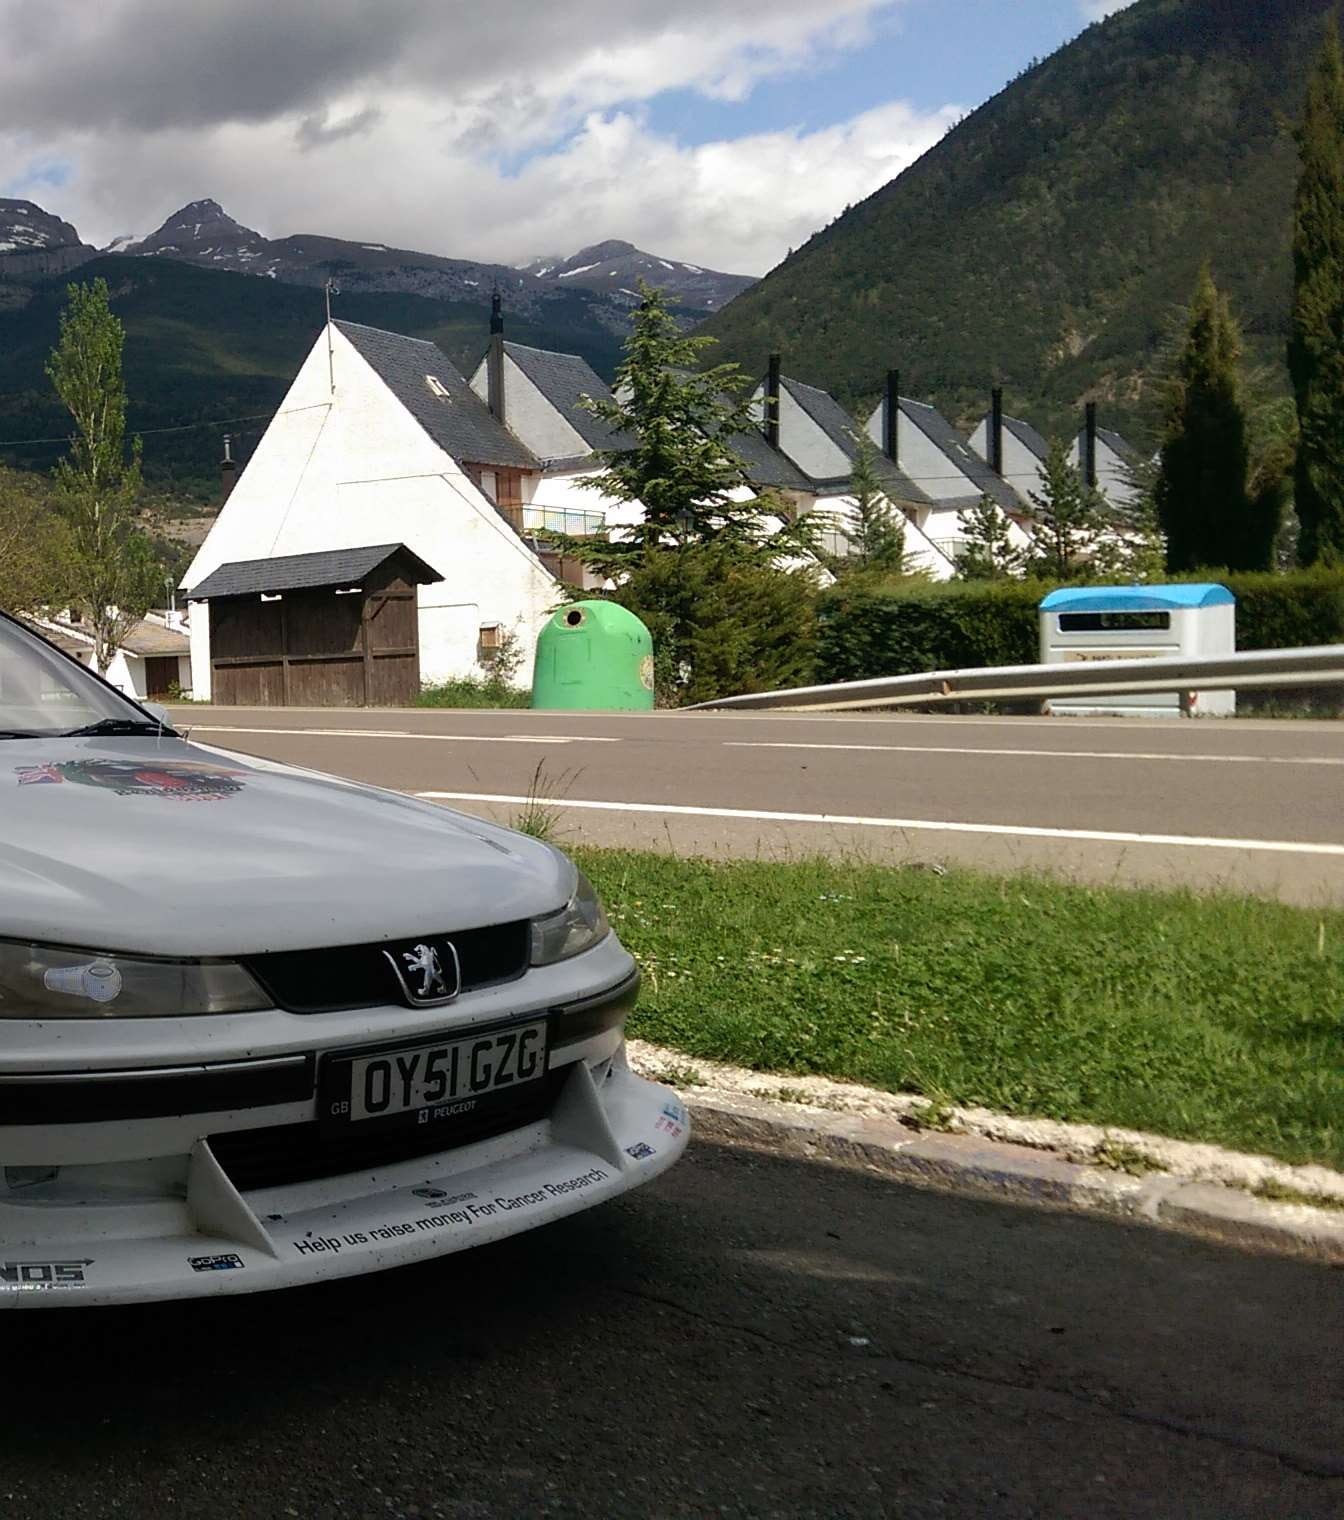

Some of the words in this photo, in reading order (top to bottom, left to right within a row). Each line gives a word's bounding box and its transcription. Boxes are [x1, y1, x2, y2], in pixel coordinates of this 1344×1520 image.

[365, 1047, 458, 1113] OY51
[470, 1029, 538, 1092] GZG
[331, 1101, 349, 1115] GB
[433, 1100, 477, 1118] PEUGEOT
[293, 1236, 341, 1254] Help
[343, 1231, 368, 1246] us
[369, 1222, 416, 1241] raise
[416, 1209, 472, 1230] money
[468, 1201, 497, 1219] For
[496, 1189, 547, 1211] Cancer
[544, 1168, 608, 1197] Research
[189, 1254, 238, 1267] GoPro
